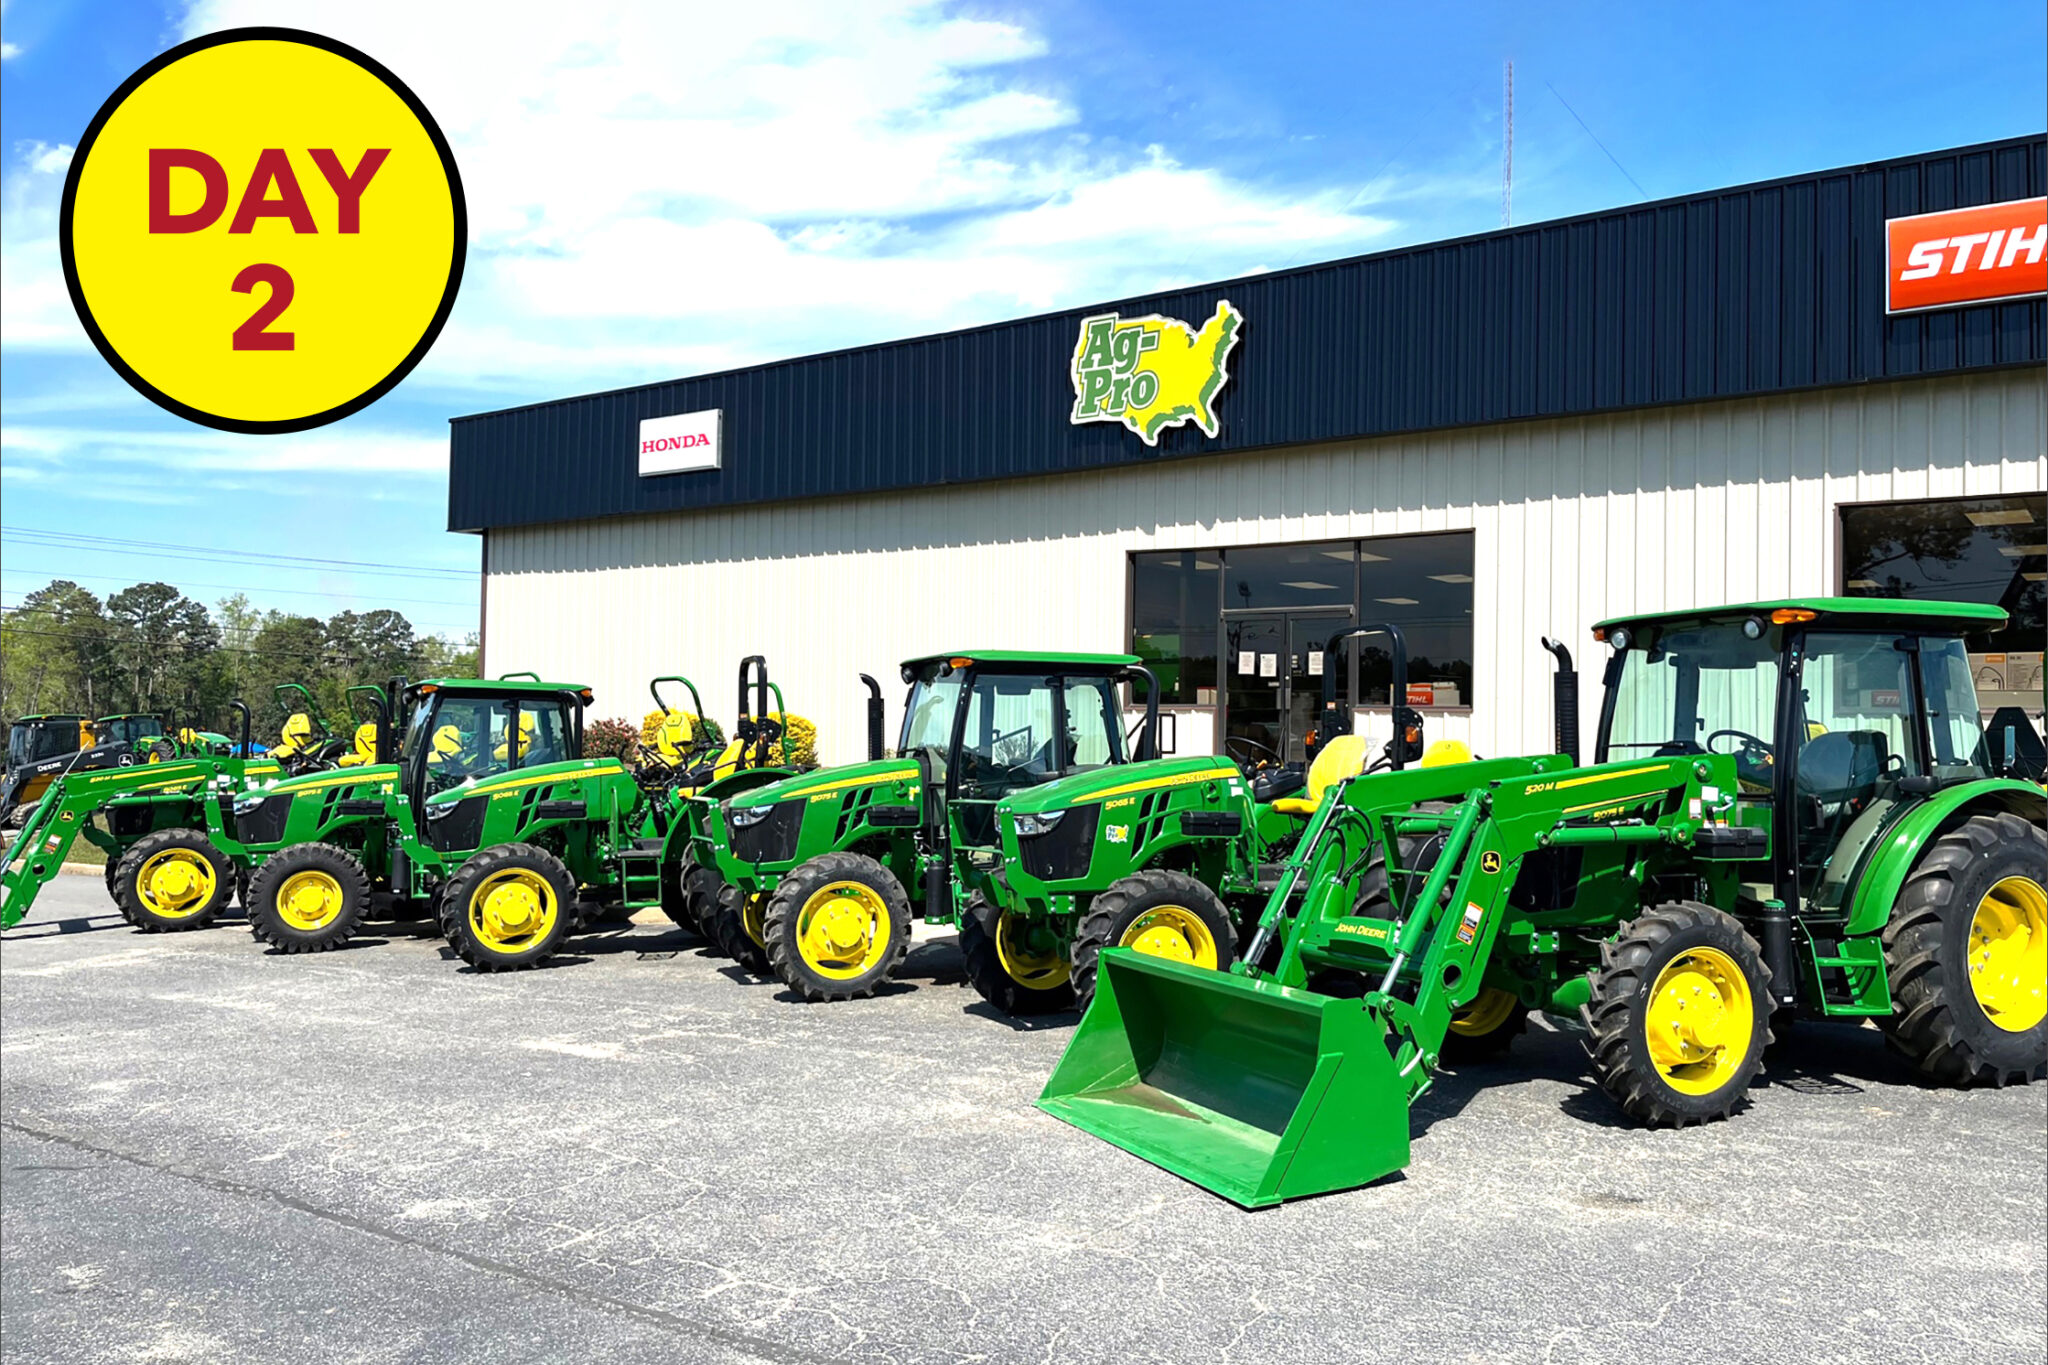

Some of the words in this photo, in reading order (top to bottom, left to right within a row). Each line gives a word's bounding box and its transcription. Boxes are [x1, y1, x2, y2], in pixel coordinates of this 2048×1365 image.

[1899, 223, 2047, 281] STIH
[1077, 367, 1159, 417] Pro
[641, 433, 711, 454] HONDA
[1406, 695, 1428, 704] TIHL
[37, 761, 62, 772] DEERE
[1524, 784, 1544, 795] 520
[1544, 782, 1554, 791] M
[810, 793, 831, 803] 5075
[1105, 798, 1129, 810] 5065
[1130, 797, 1136, 805] E
[1593, 808, 1618, 822] 5075
[1618, 807, 1625, 815] E
[1335, 923, 1357, 933] JOHN
[1357, 924, 1388, 939] DEERE
